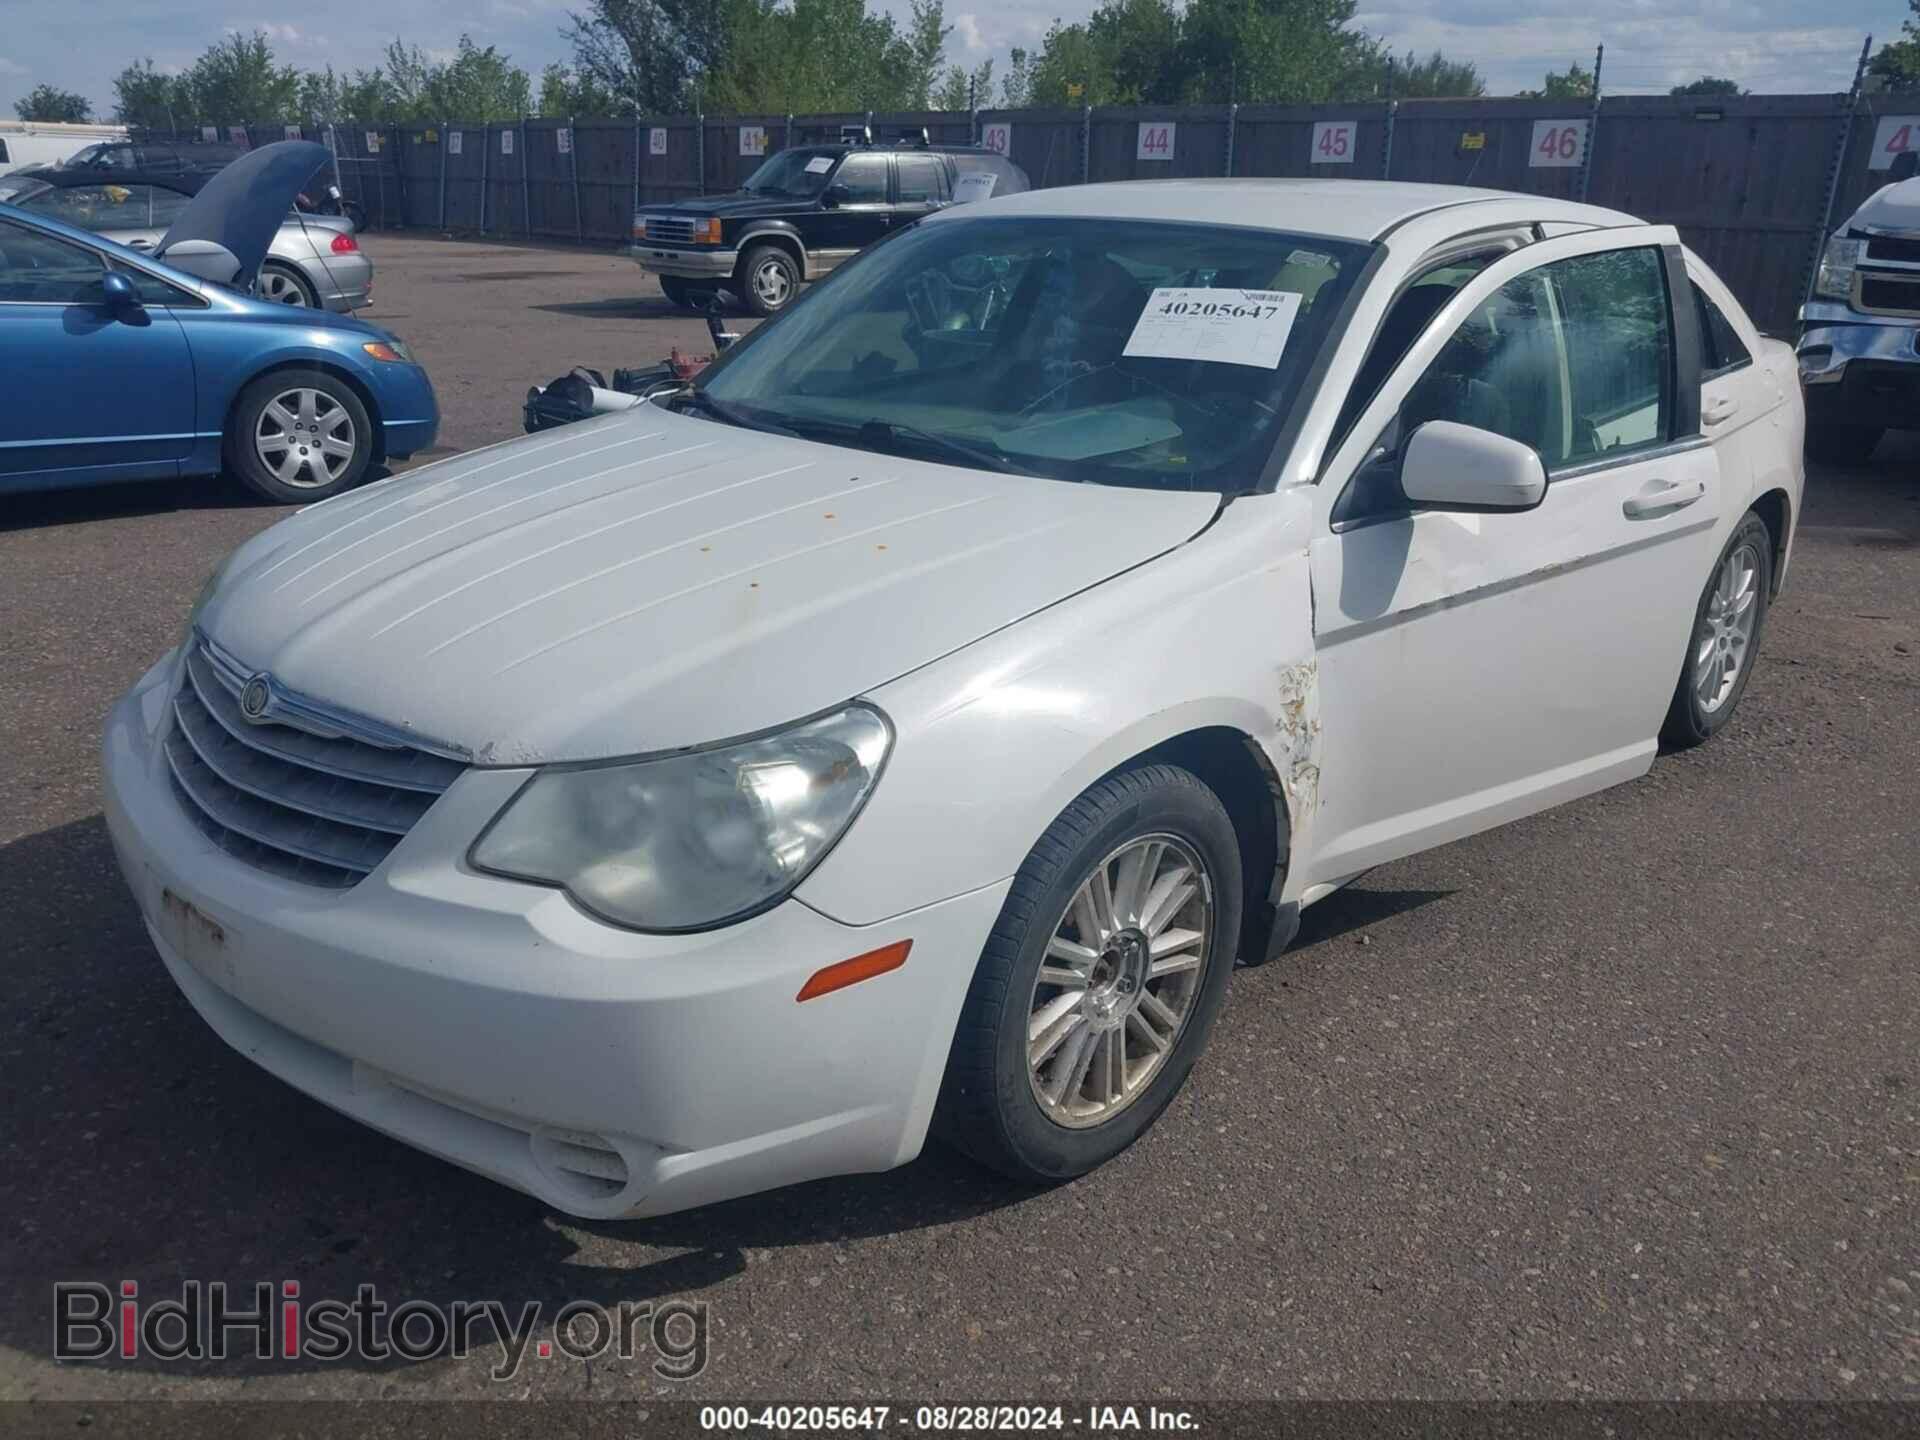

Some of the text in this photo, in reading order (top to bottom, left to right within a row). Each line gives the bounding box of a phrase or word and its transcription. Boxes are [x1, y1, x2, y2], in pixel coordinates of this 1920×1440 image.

[986, 127, 1006, 151] 43
[1142, 127, 1169, 153] 44
[1318, 127, 1348, 156] 45
[1538, 126, 1578, 159] 46
[1159, 301, 1279, 320] 40205647
